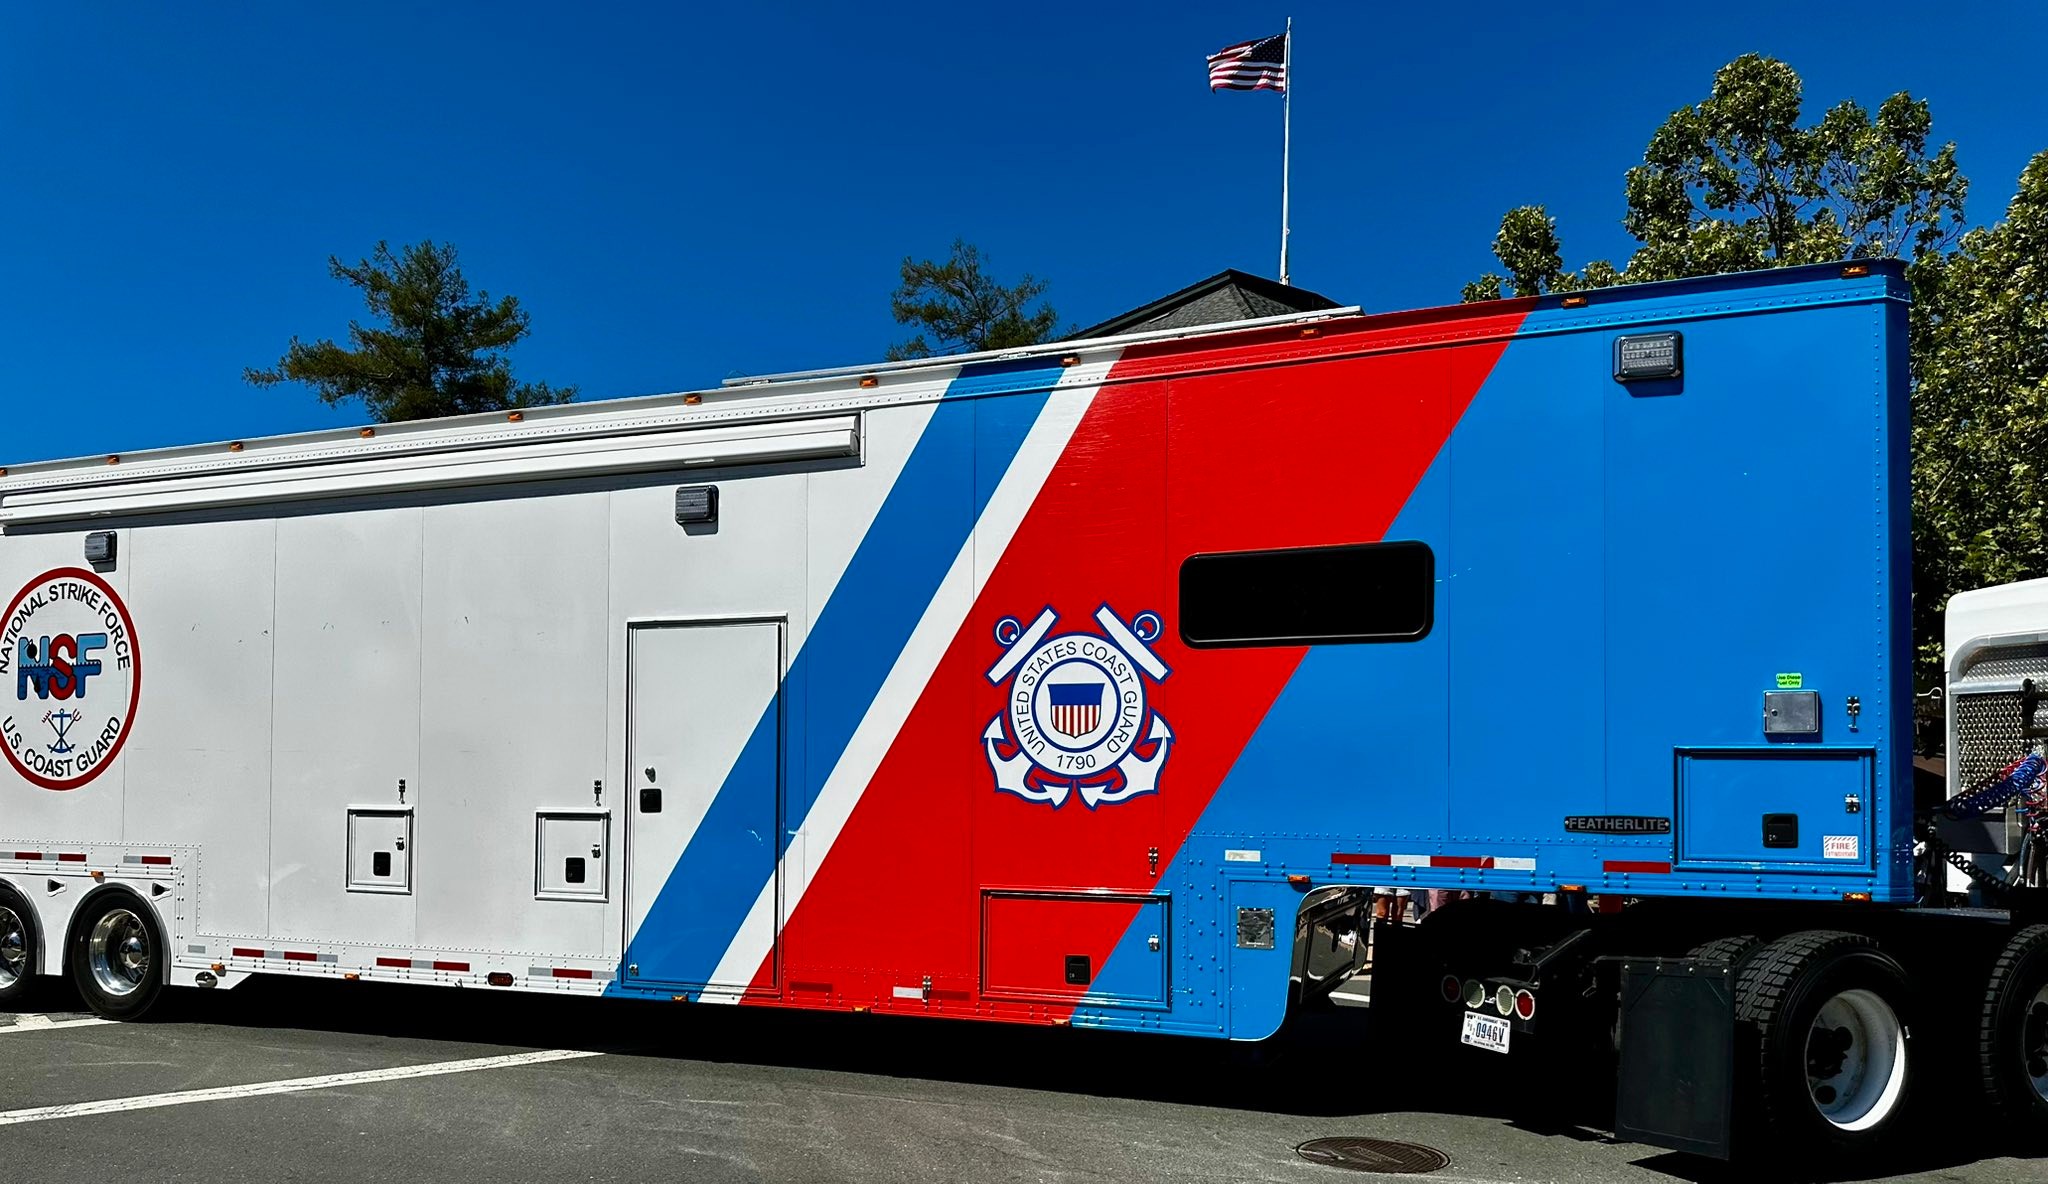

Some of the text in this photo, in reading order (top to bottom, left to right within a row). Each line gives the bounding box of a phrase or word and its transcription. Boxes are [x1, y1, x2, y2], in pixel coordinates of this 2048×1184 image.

[0, 582, 130, 674] NATIONAL STRIKE FORCE
[17, 633, 107, 700] NSF
[1016, 641, 1138, 755] UNITED STATES COAST GUARD
[2, 715, 121, 777] U.S. COAST GUARD
[1056, 754, 1096, 770] 1790
[1568, 817, 1666, 830] FEATHERLITE
[1831, 842, 1850, 850] FIRE
[1476, 1022, 1505, 1043] 0946V
